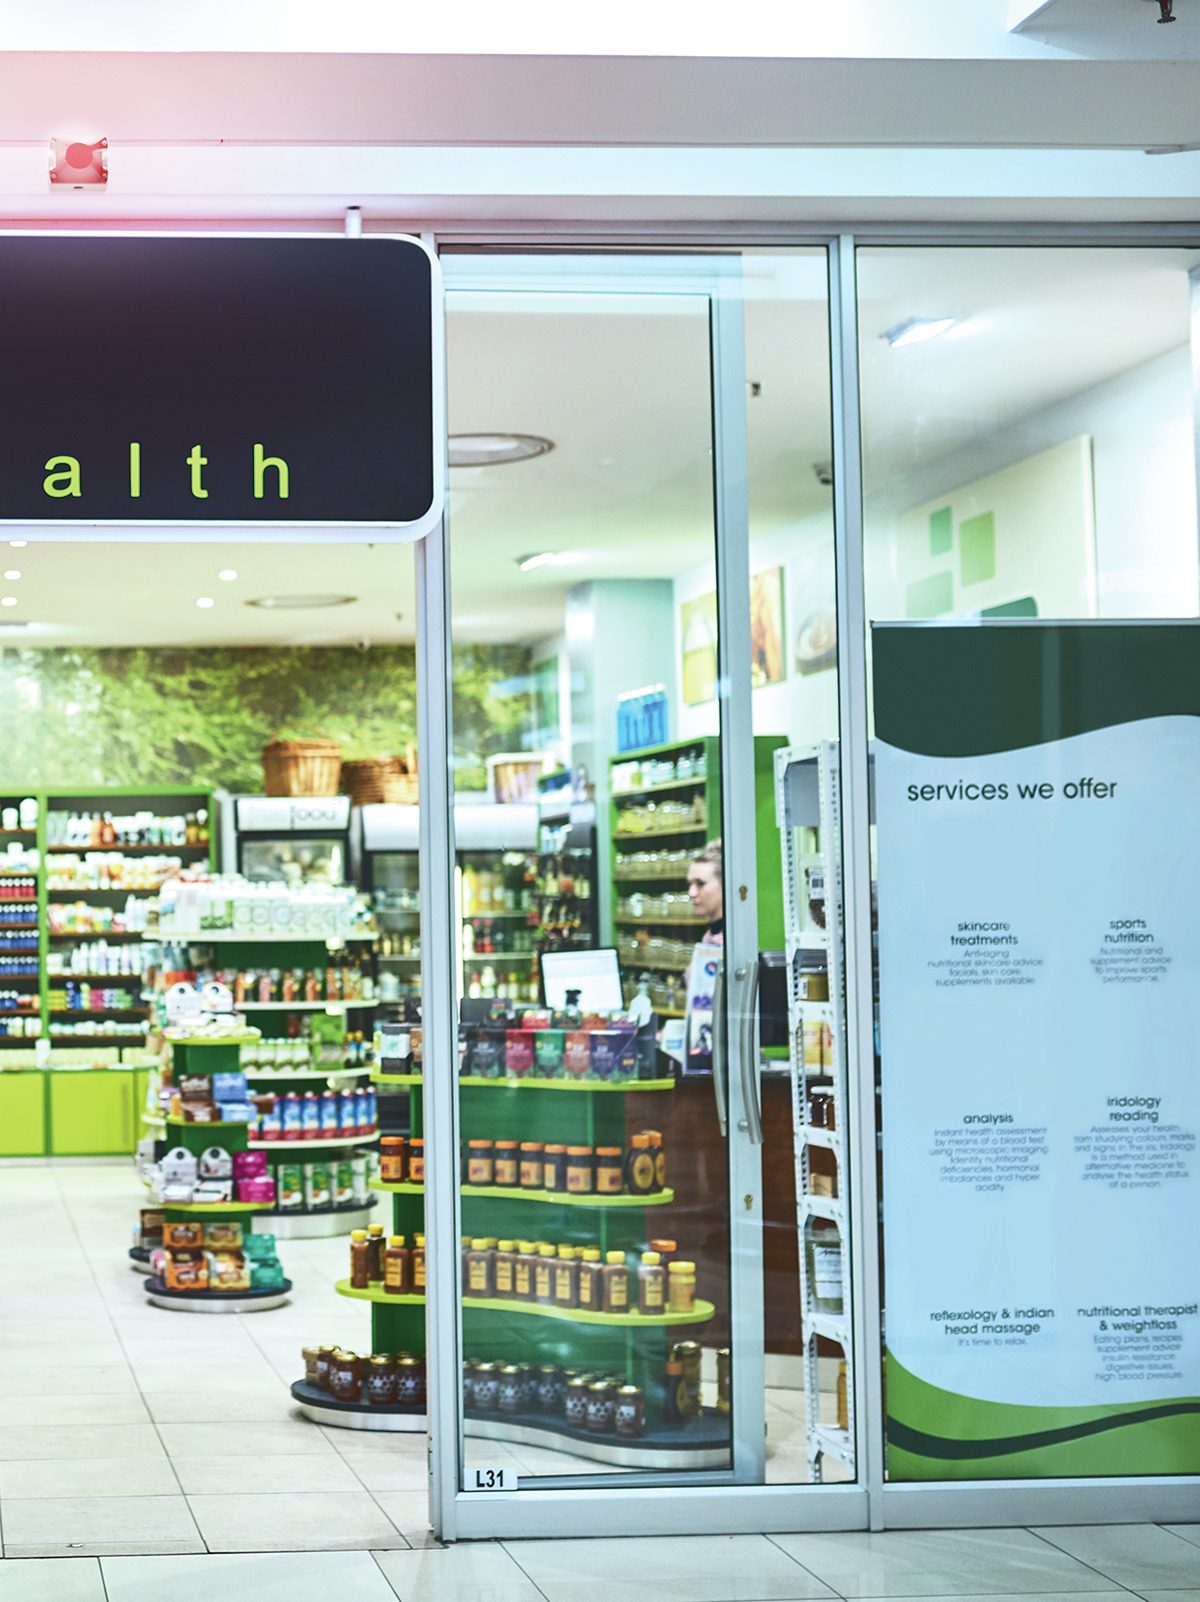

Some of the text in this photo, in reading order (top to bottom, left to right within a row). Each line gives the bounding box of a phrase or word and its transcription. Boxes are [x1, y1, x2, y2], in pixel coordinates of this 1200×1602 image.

[907, 777, 1118, 801] services we offer
[957, 921, 1011, 932] skincare
[1110, 919, 1147, 930] sports
[950, 934, 1019, 946] treatments
[1104, 932, 1155, 943] nutrition
[1144, 947, 1164, 955] and
[1107, 1096, 1162, 1109] iridology
[963, 1113, 1015, 1125] analysis
[1109, 1110, 1159, 1123] reading
[965, 1128, 994, 1136] health
[1132, 1126, 1150, 1134] your
[1000, 1136, 1027, 1144] blood
[930, 1148, 953, 1157] using
[1074, 1145, 1091, 1153] and
[1092, 1144, 1117, 1153] signs
[1015, 1173, 1041, 1182] hyper
[930, 1308, 1055, 1323] reflexology & indian
[1077, 1304, 1198, 1317] nutritional therapist
[944, 1323, 1041, 1336] head massage
[1099, 1319, 1178, 1334] & weightloss
[476, 1469, 503, 1488] L31
